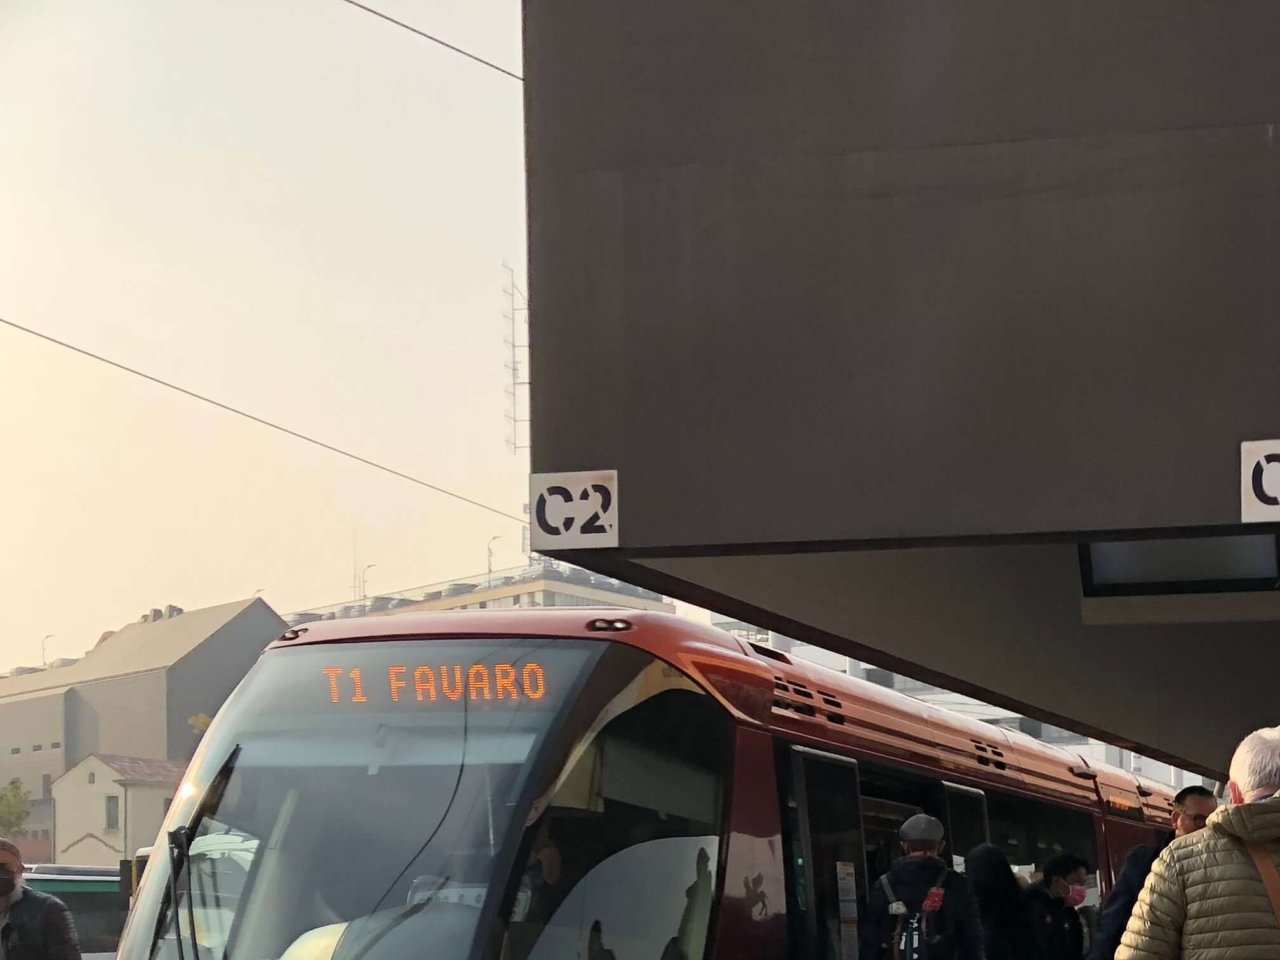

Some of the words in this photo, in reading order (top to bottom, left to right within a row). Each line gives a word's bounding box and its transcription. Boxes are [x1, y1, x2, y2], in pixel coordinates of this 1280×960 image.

[536, 484, 612, 536] C2
[322, 666, 367, 703] T1
[388, 662, 545, 702] FAVARO
